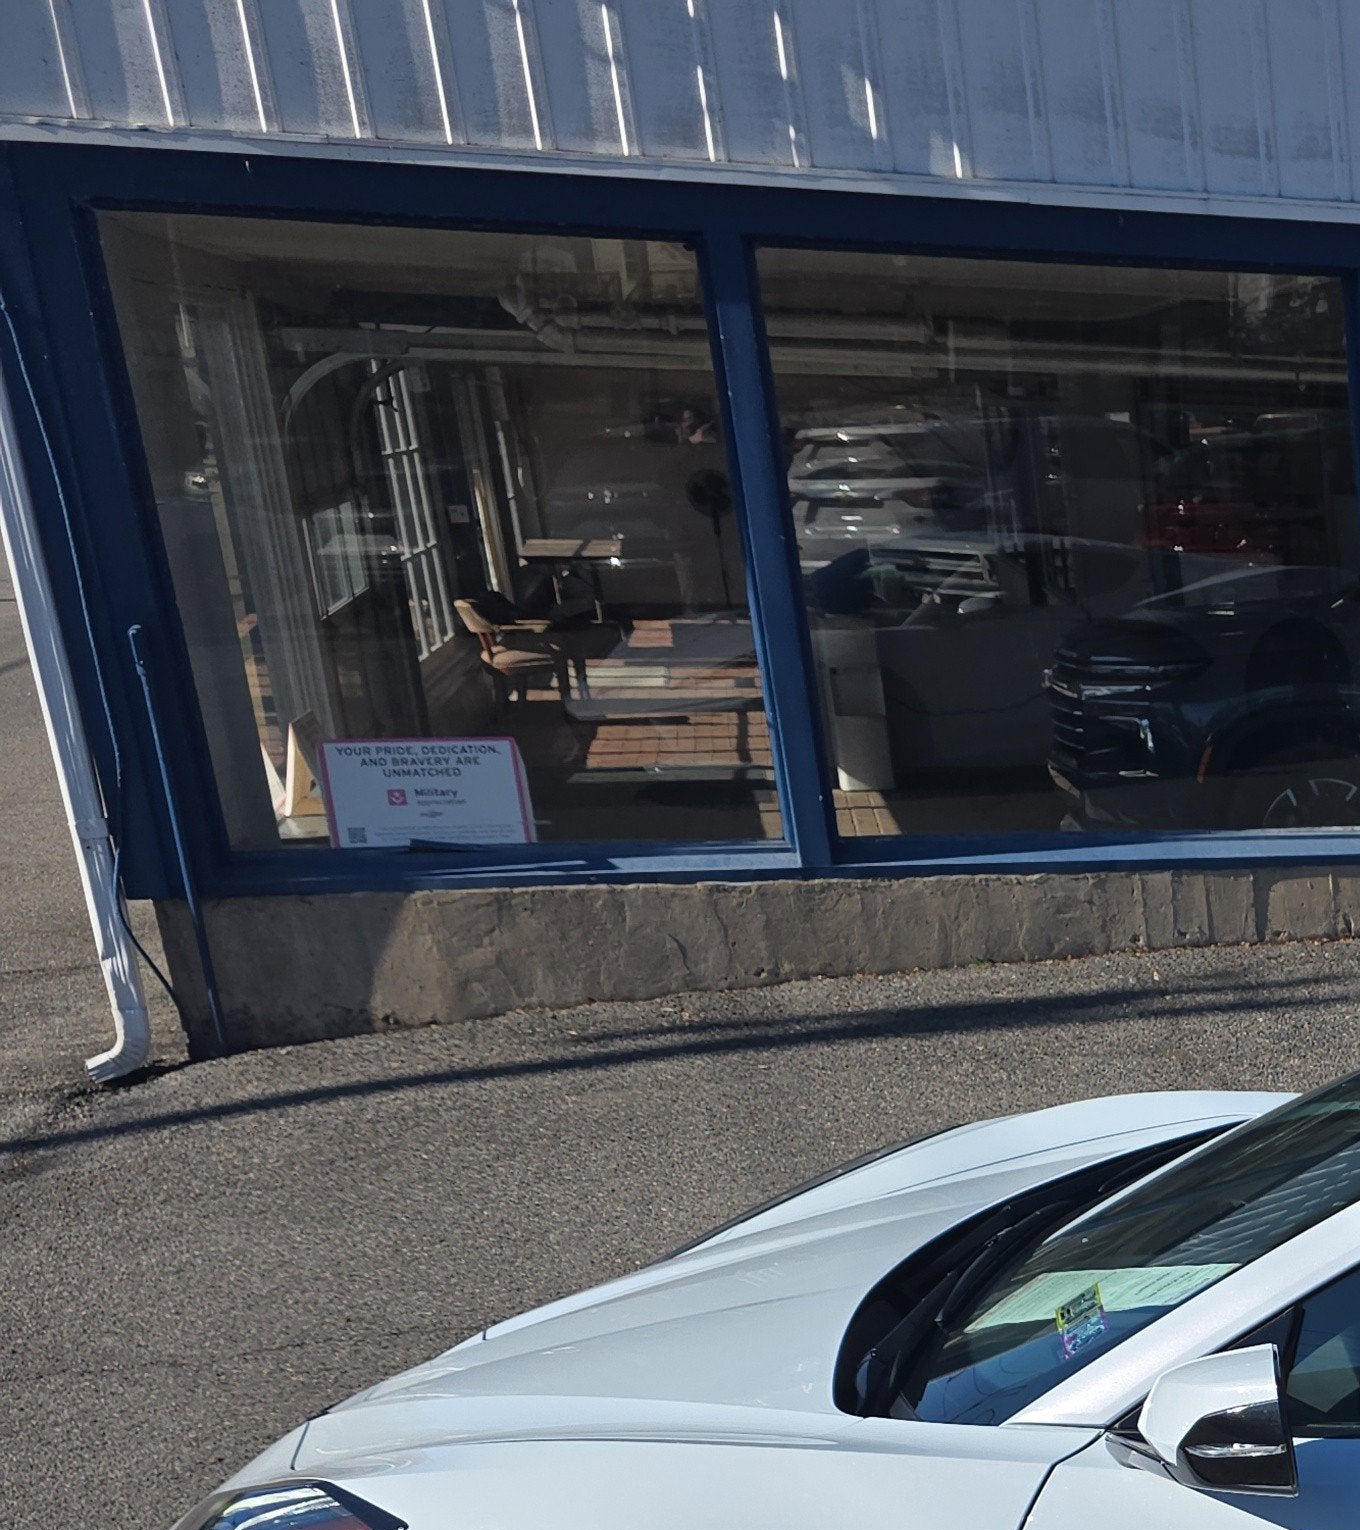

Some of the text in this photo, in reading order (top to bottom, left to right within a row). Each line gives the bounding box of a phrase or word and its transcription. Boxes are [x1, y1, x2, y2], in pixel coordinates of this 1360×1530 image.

[336, 746, 371, 756] YOUR
[374, 746, 418, 757] PRIDE,
[360, 756, 481, 767] AND BRAVERY ARE
[383, 767, 462, 777] UNMATCHED
[414, 788, 458, 798] Military
